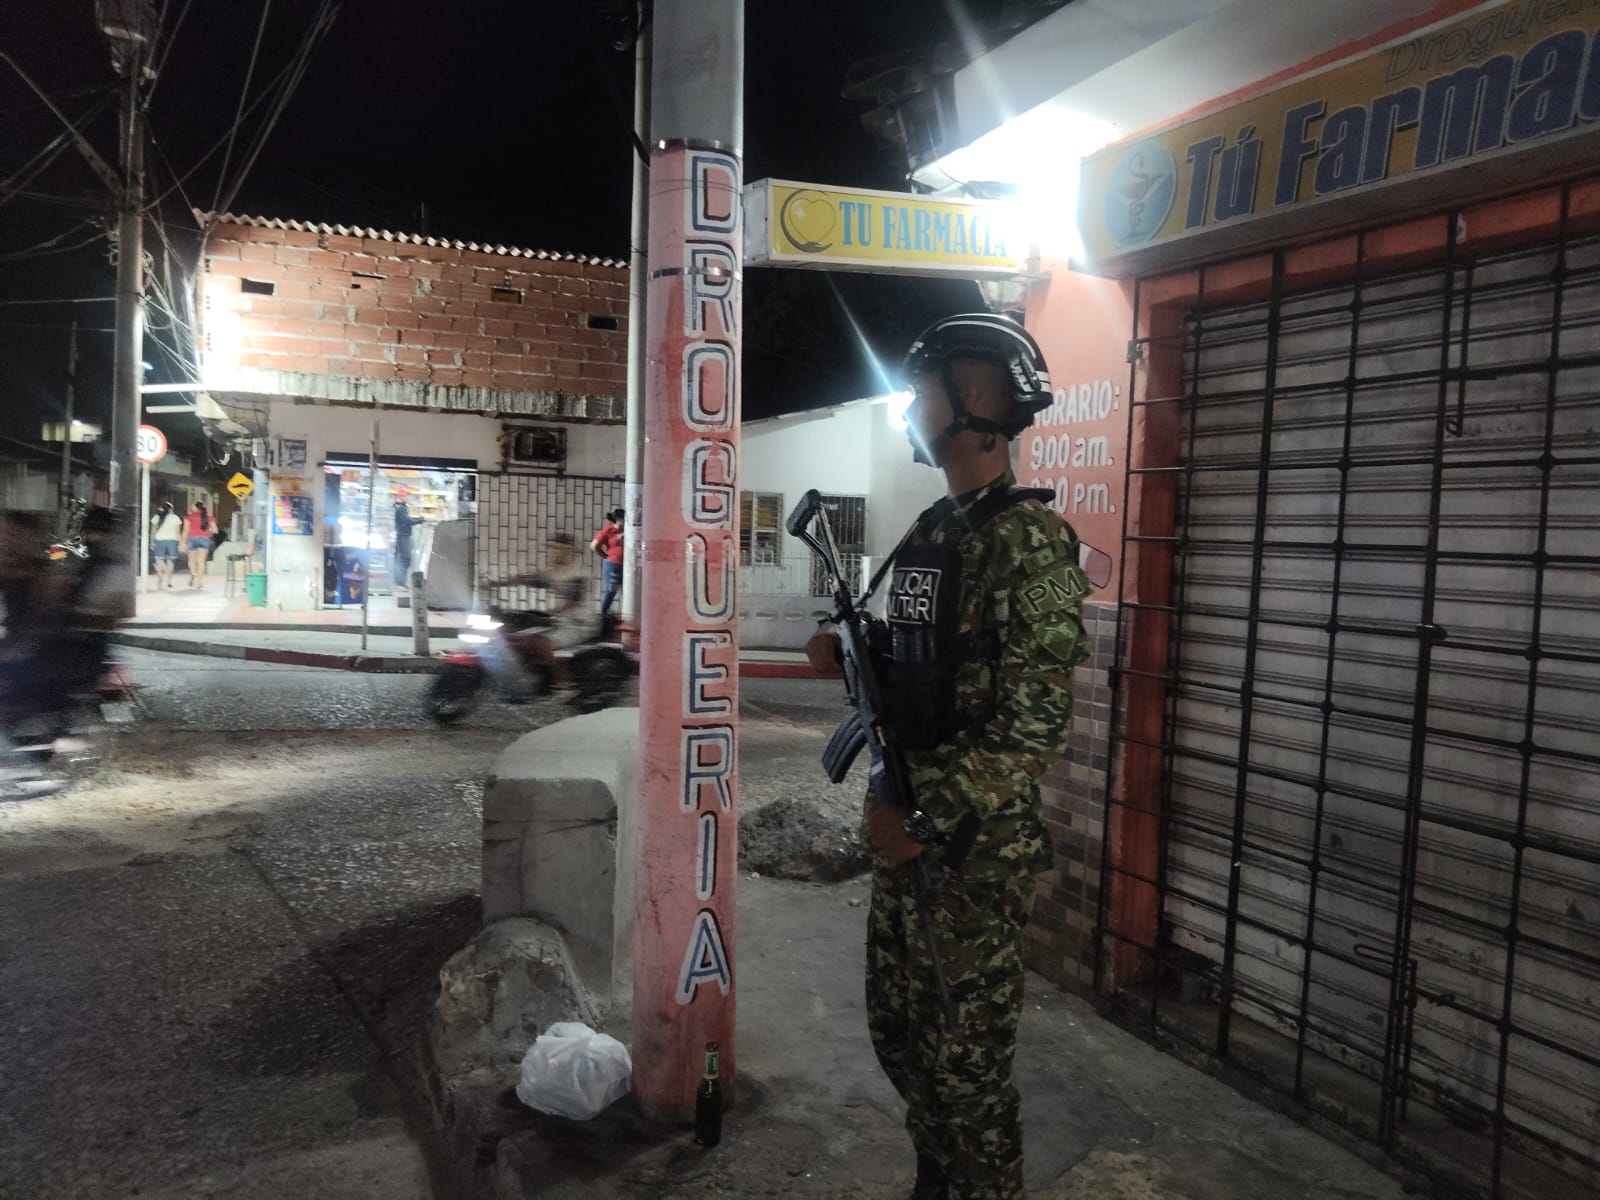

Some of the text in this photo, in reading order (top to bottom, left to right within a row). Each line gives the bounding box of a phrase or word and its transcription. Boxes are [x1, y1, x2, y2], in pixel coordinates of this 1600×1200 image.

[1185, 122, 1263, 231] Tú
[839, 201, 873, 247] TU
[1072, 435, 1114, 468] am.
[675, 149, 742, 1006] DROGUERIA
[1020, 566, 1086, 614] PM
